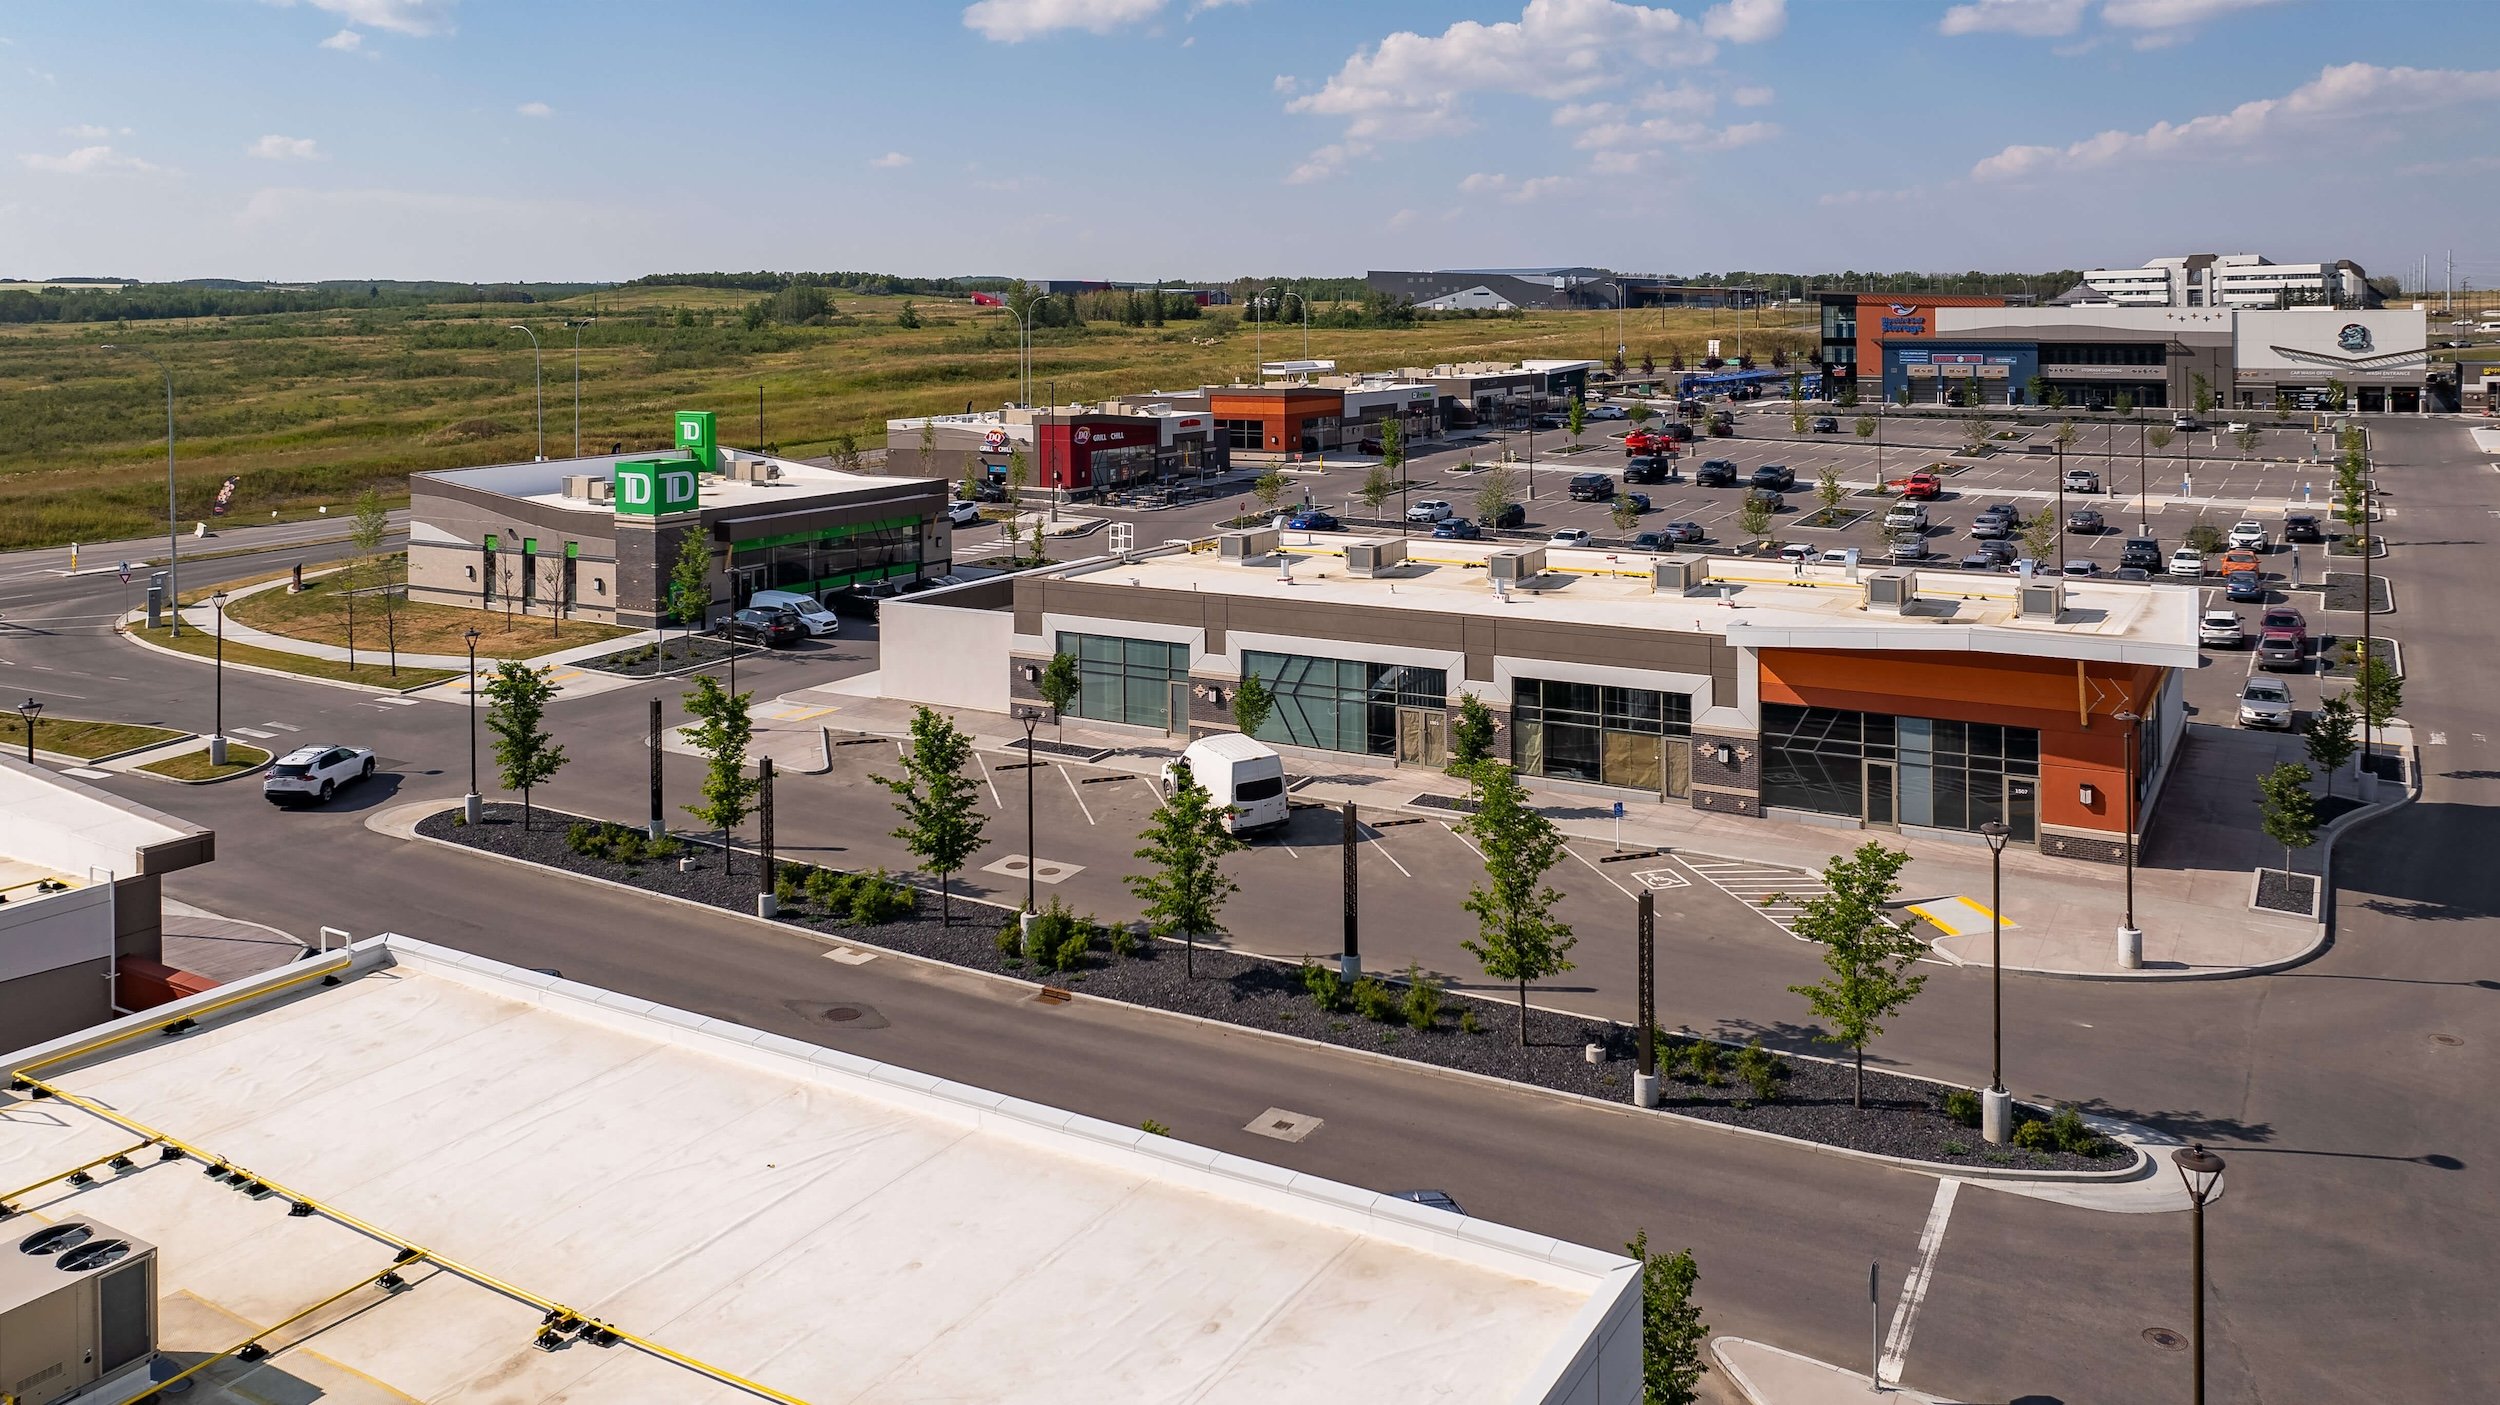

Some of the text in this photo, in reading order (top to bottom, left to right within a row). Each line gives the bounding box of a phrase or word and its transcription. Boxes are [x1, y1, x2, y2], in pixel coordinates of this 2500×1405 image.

[680, 421, 700, 440] TD
[988, 432, 1001, 442] DQ
[1078, 431, 1089, 440] DQ
[1093, 432, 1124, 442] GRILL CHILL
[618, 471, 651, 505] TD
[658, 470, 695, 504] TD
